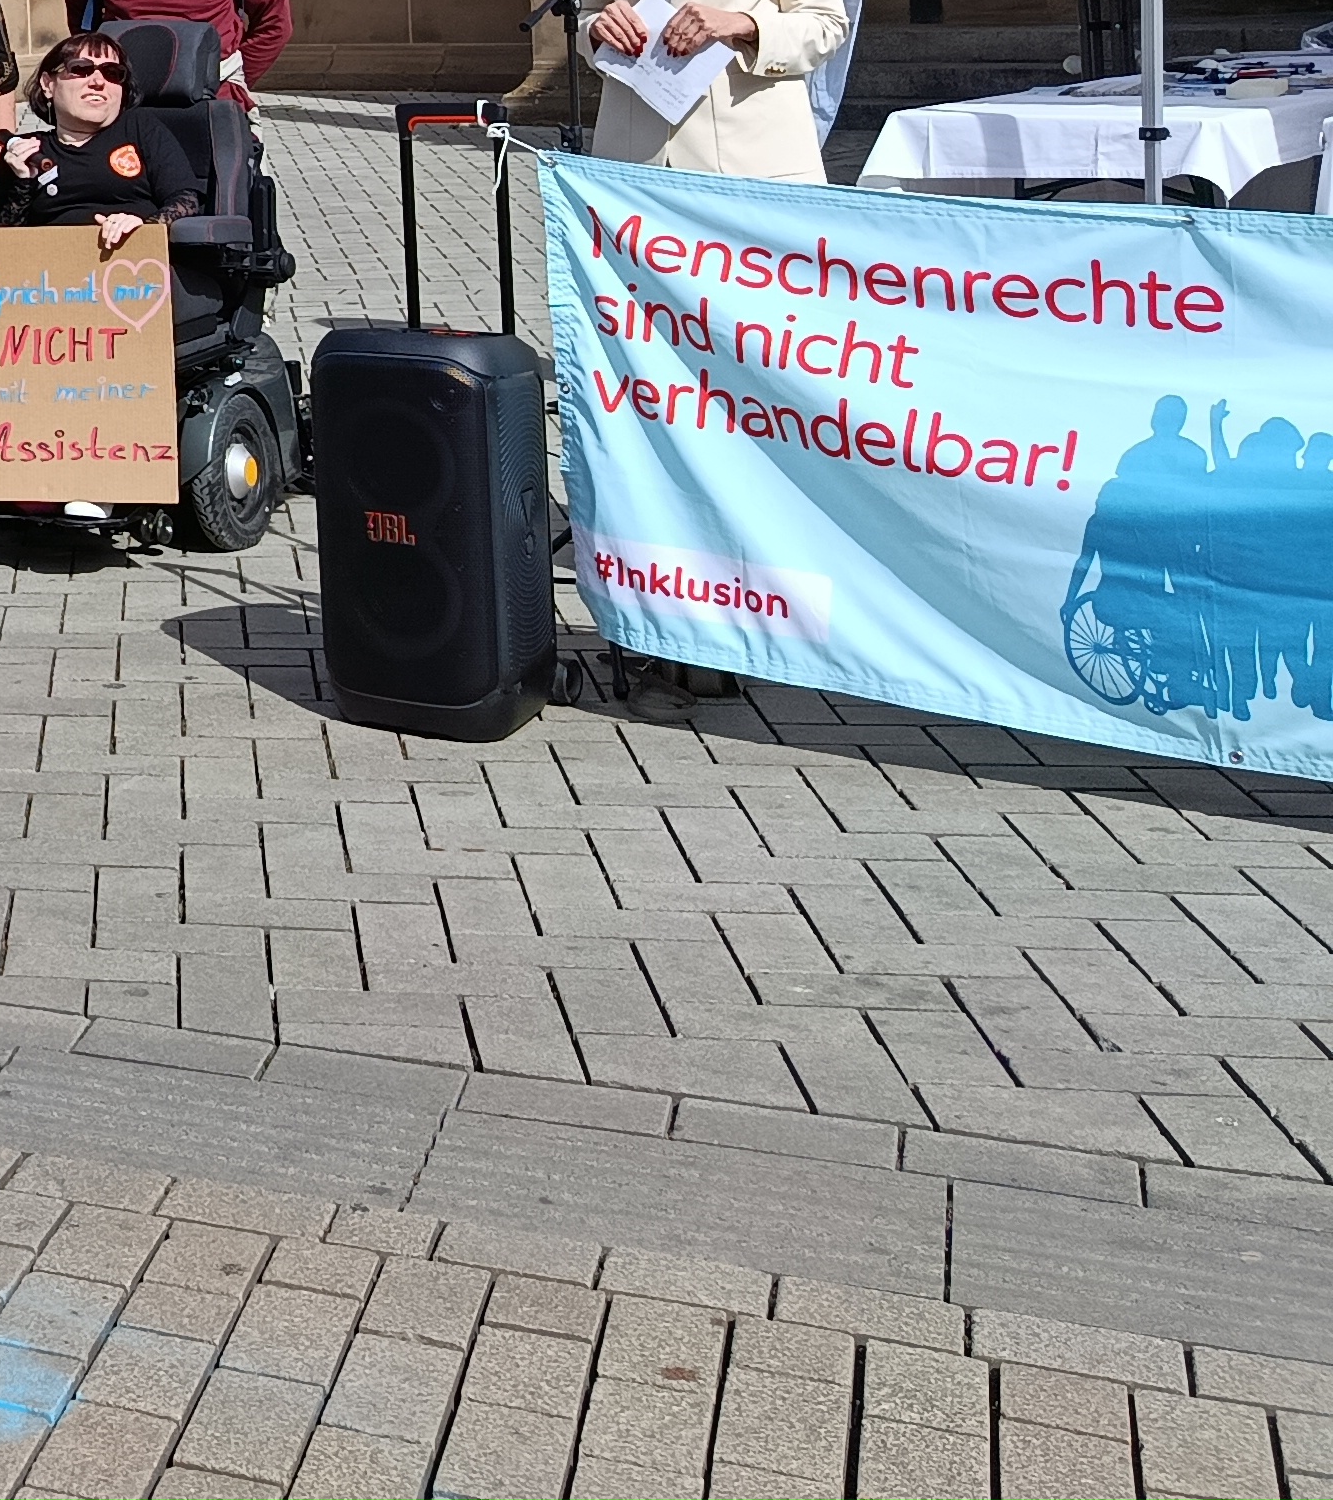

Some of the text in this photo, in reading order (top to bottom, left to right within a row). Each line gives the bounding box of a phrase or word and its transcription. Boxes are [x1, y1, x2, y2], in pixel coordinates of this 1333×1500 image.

[64, 268, 101, 305] mit
[585, 204, 1225, 334] Menschenrechte
[594, 282, 920, 389] sind nicht
[53, 375, 158, 405] meiner
[592, 368, 1079, 493] verhandelbar!
[364, 510, 417, 547] JBL
[593, 551, 790, 620] #Inklusion
